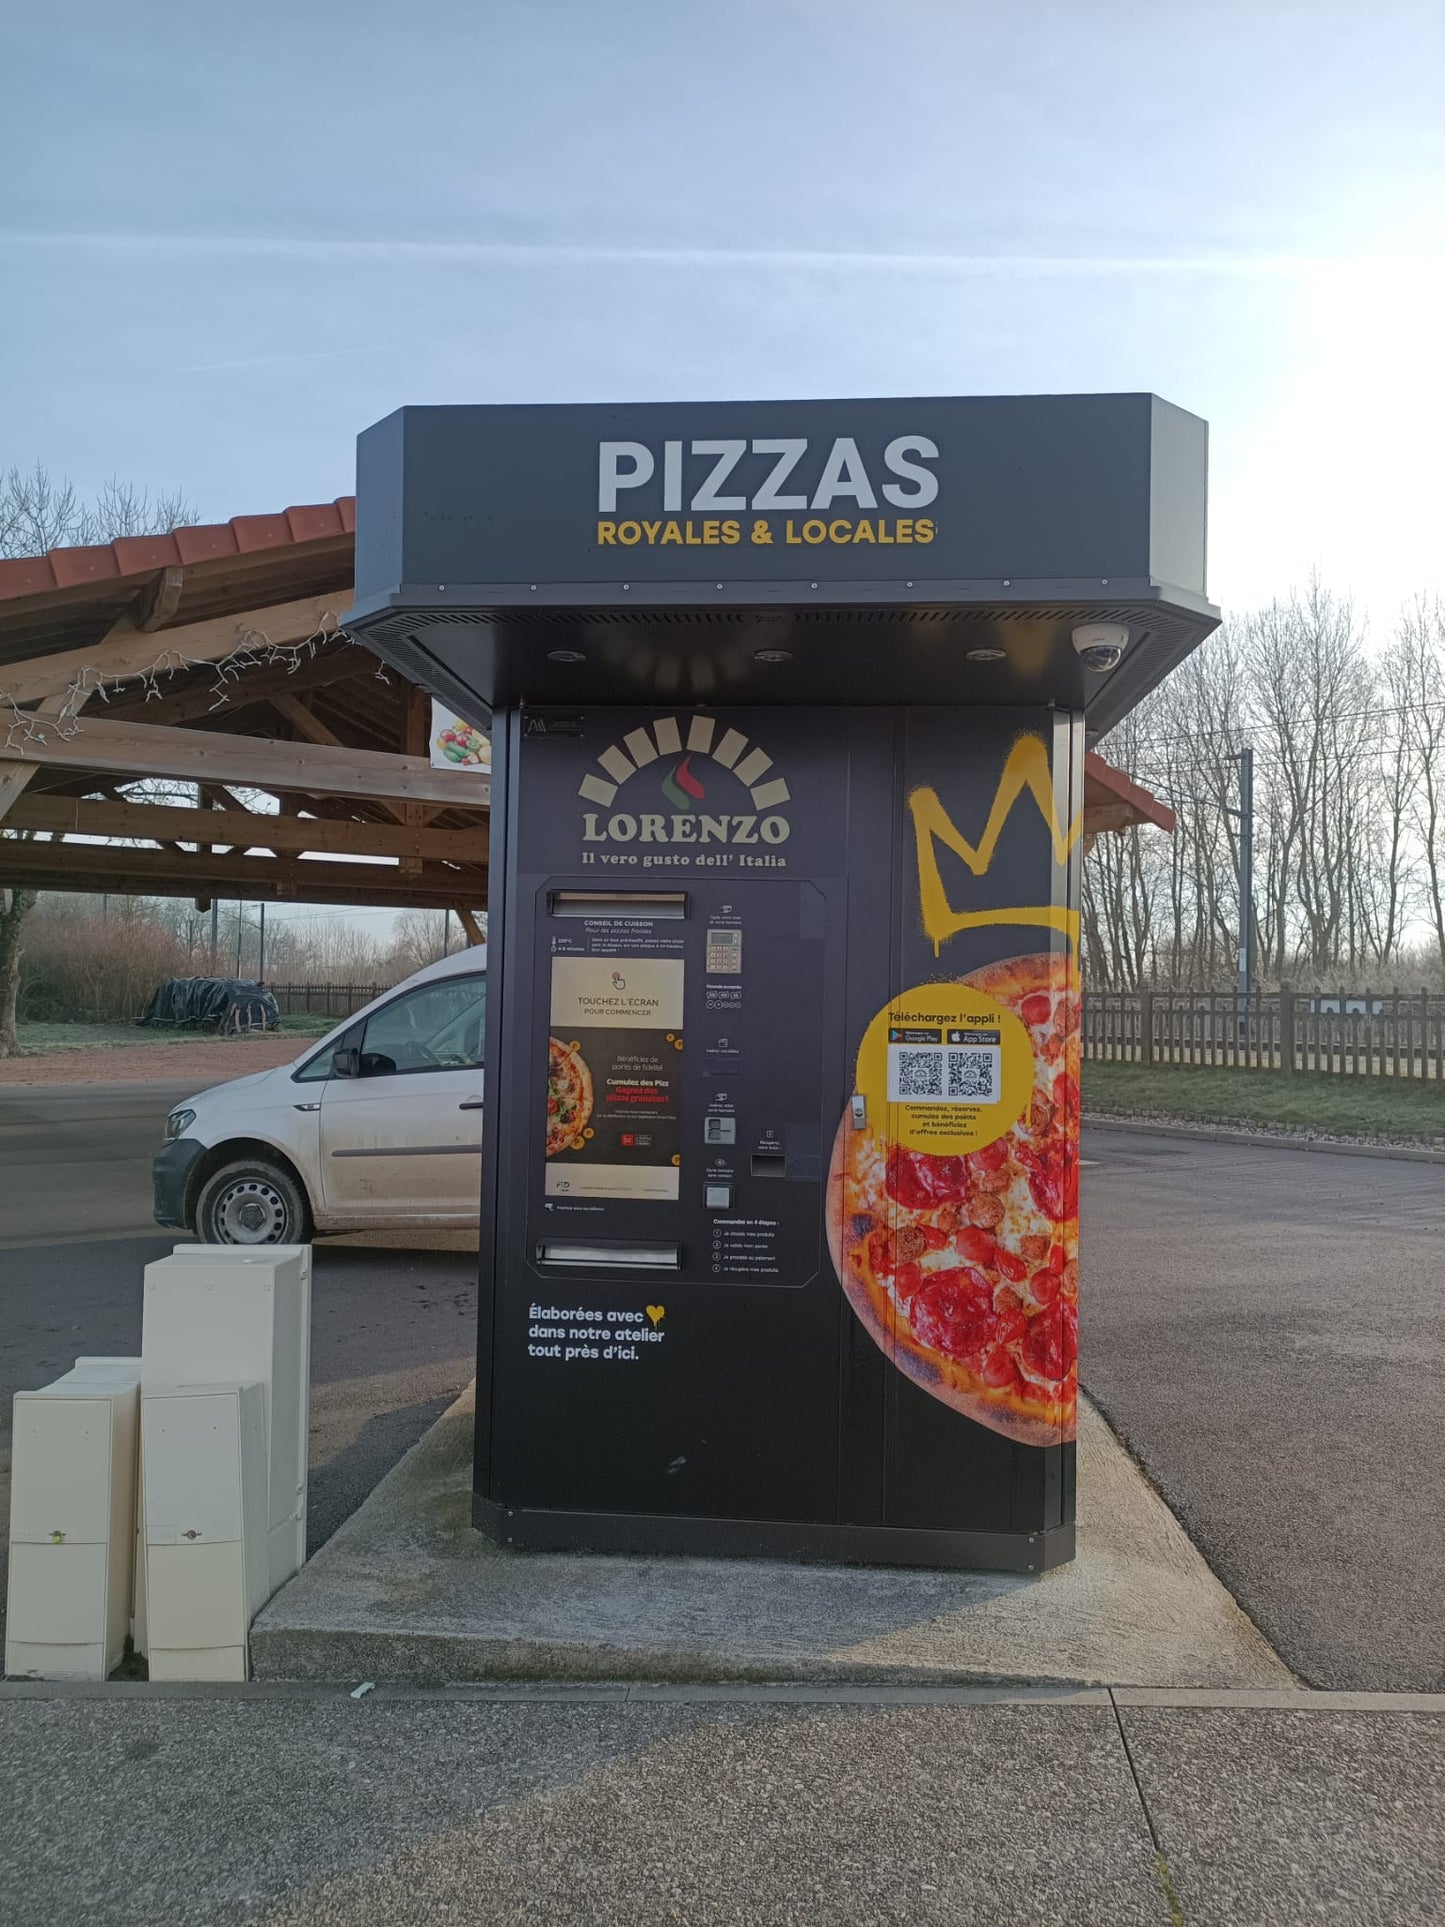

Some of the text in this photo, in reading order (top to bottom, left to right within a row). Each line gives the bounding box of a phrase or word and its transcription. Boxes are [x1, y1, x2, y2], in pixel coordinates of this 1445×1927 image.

[598, 435, 940, 513] PIZZAS
[597, 519, 935, 545] ROYALES & LOCALES
[581, 813, 791, 844] LORENZO
[581, 852, 595, 865] Il
[600, 853, 637, 865] vero
[642, 853, 690, 867] gusto
[739, 855, 787, 867] Italia
[624, 920, 653, 928] CUISSON
[578, 997, 619, 1006] TOUCHEZ
[605, 1008, 651, 1017] COMMENCER
[888, 1011, 956, 1025] Téléchargez
[905, 1035, 939, 1043] Google Play
[963, 1036, 978, 1044] App
[606, 1079, 639, 1087] Cumulez
[640, 1079, 654, 1087] des
[528, 1302, 644, 1323] Élaborées avec
[528, 1325, 665, 1342] dans notre atelier
[528, 1344, 561, 1357] tout
[565, 1344, 599, 1361] près
